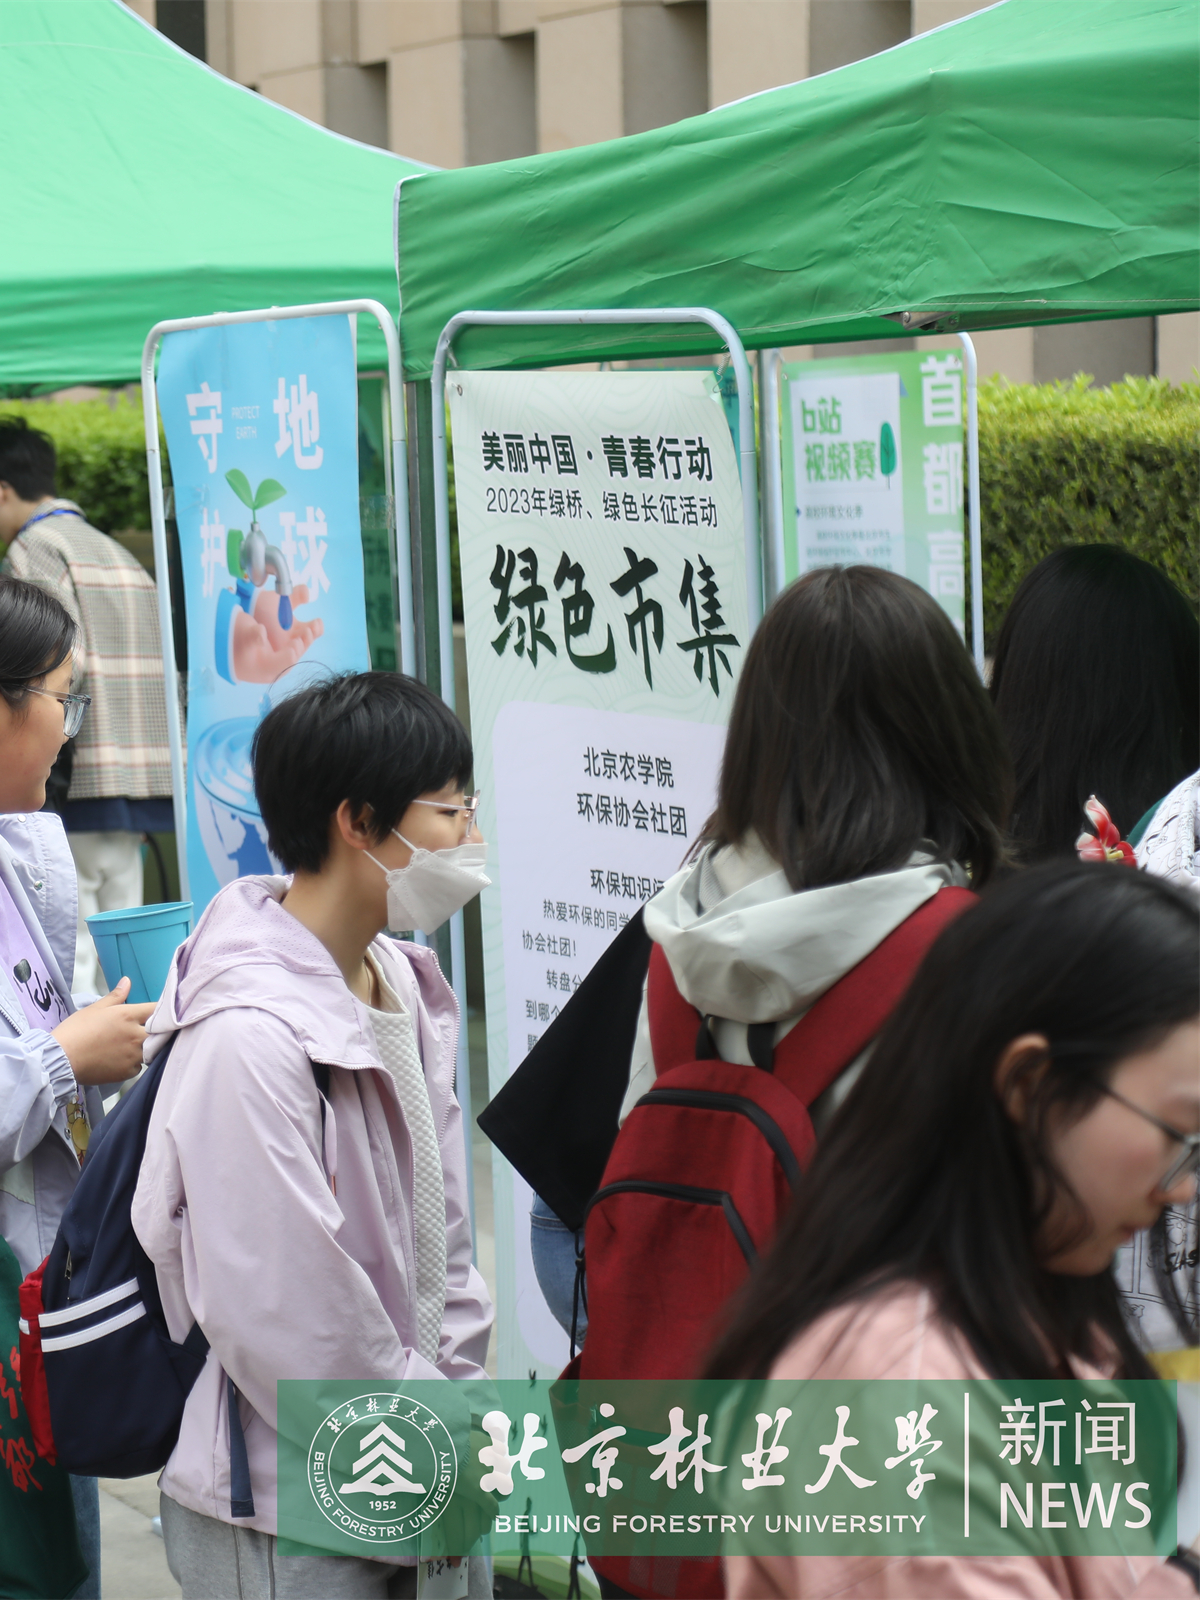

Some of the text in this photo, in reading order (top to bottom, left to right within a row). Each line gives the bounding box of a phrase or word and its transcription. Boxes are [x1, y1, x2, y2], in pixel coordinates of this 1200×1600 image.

[231, 405, 261, 420] PROTECT
[236, 425, 258, 440] EARTH
[801, 395, 842, 435] b站
[804, 439, 877, 483] 视频赛
[486, 486, 719, 529] 2023年绿桥、绿色长征活动
[919, 354, 965, 637] 首都高
[489, 544, 742, 699] 绿色市集
[583, 746, 675, 788] 北京农学院
[576, 792, 688, 838] 环保协会社团
